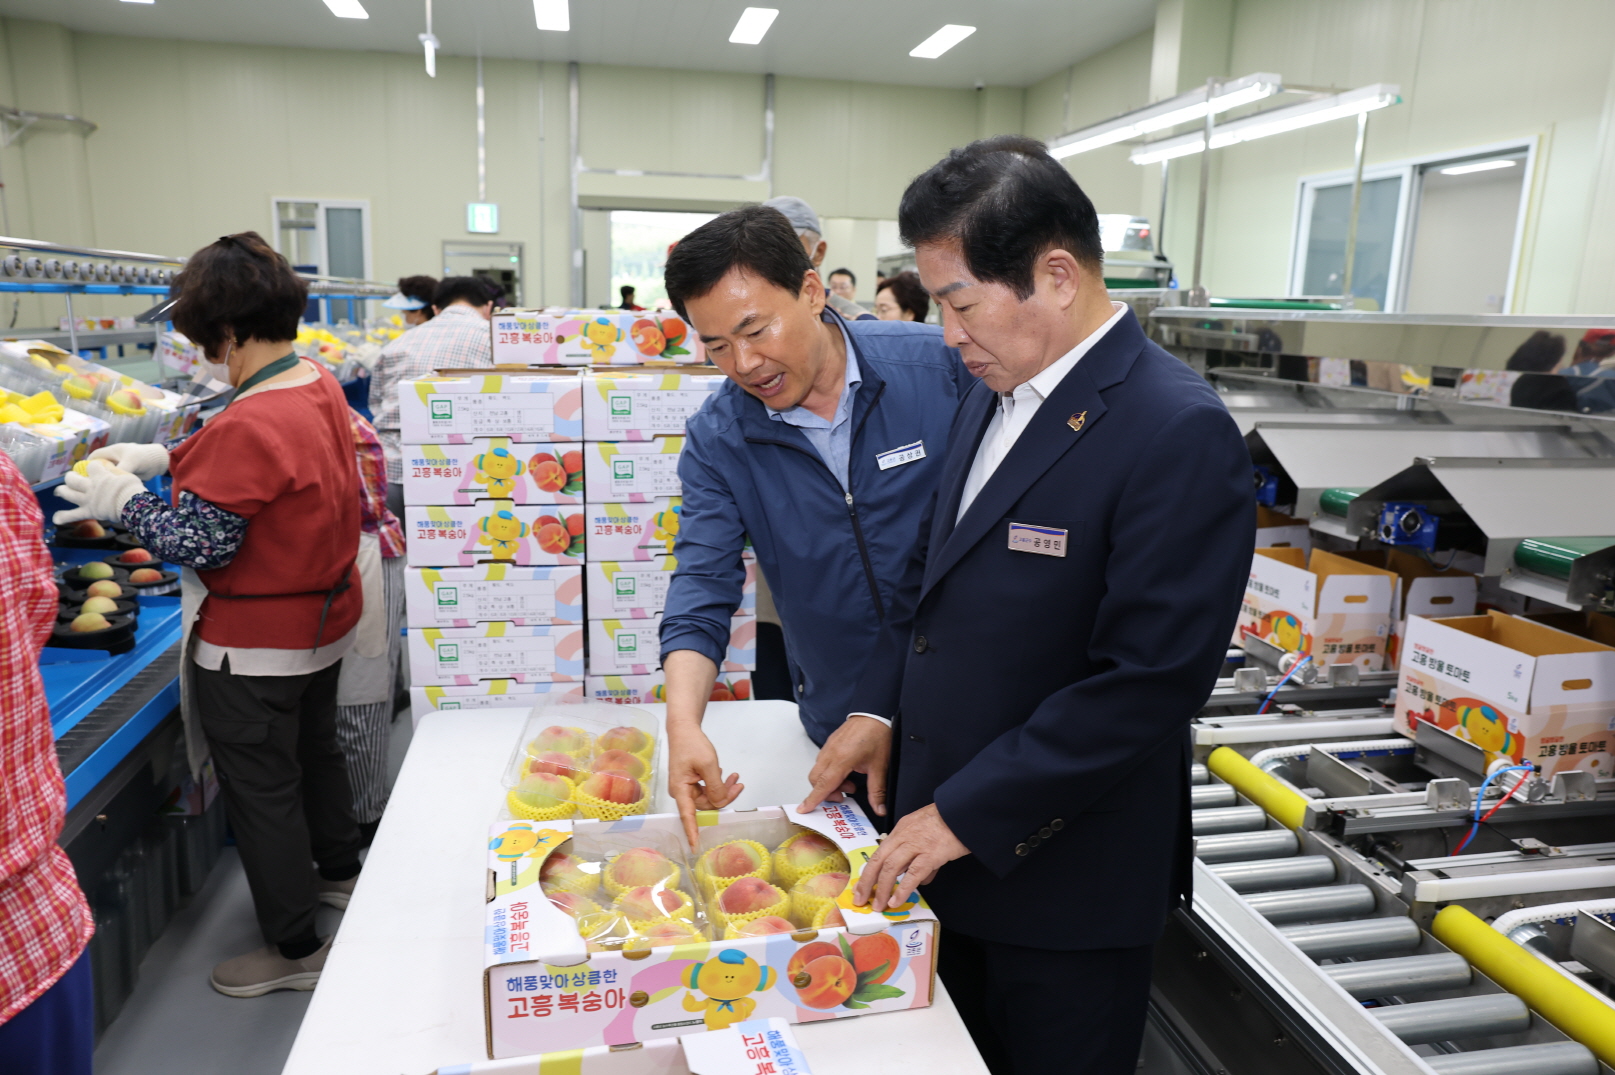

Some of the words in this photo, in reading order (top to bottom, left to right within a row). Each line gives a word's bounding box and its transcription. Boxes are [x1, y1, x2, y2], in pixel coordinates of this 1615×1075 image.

[499, 332, 520, 344] 고흥
[522, 332, 553, 344] 복숭아
[412, 467, 431, 478] 고흥
[433, 467, 462, 478] 복숭아
[417, 529, 436, 540] 고흥
[438, 529, 466, 539] 복숭아
[594, 525, 613, 535] 고흥
[615, 525, 642, 535] 복숭아
[1033, 537, 1061, 550] 공영민
[1322, 643, 1337, 654] 고흥
[1338, 643, 1353, 654] 방울
[1354, 643, 1376, 654] 토마토
[1411, 650, 1428, 667] 고흥
[1428, 657, 1445, 673] 방울
[1445, 663, 1471, 684] 토마토
[1404, 682, 1419, 697] 고흥
[1419, 686, 1435, 702] 방울
[1434, 691, 1457, 713] 토마토
[1537, 744, 1558, 758] 고흥
[1558, 742, 1578, 756] 방울
[1578, 740, 1607, 754] 토마토
[822, 805, 843, 819] 고흥
[832, 819, 857, 839] 복숭아
[509, 901, 530, 931] 복숭아
[509, 932, 530, 953] 고흥
[507, 993, 554, 1019] 고흥
[557, 987, 626, 1014] 복숭아
[741, 1032, 771, 1060] 고흥
